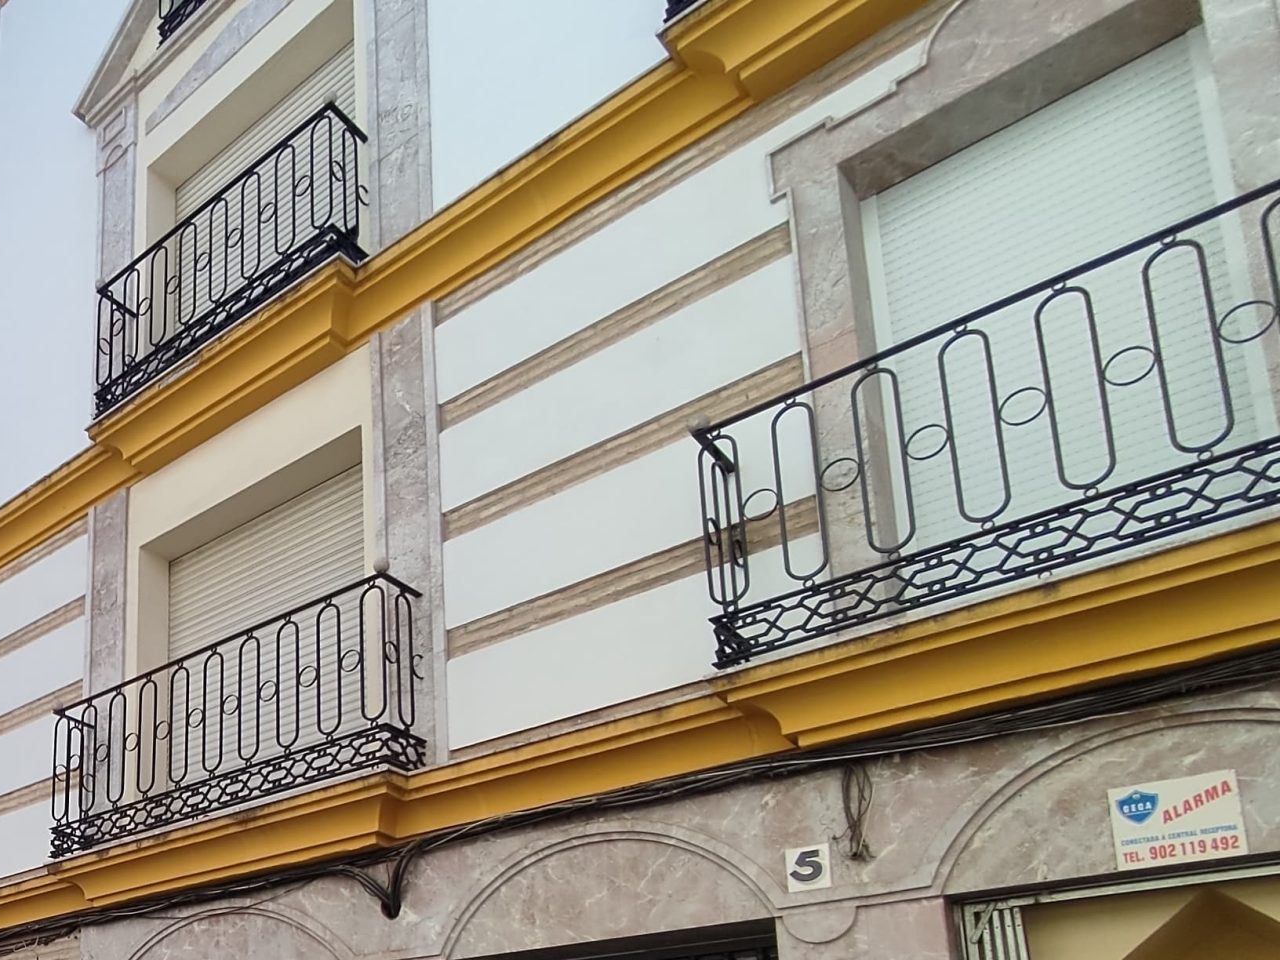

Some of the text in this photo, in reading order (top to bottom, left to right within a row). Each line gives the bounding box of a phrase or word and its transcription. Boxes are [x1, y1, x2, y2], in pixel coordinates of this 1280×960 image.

[1162, 780, 1232, 825] ALARMA
[1122, 834, 1240, 864] TEL. 902 119 492
[1167, 830, 1198, 840] CENTRAL
[789, 848, 823, 882] 5
